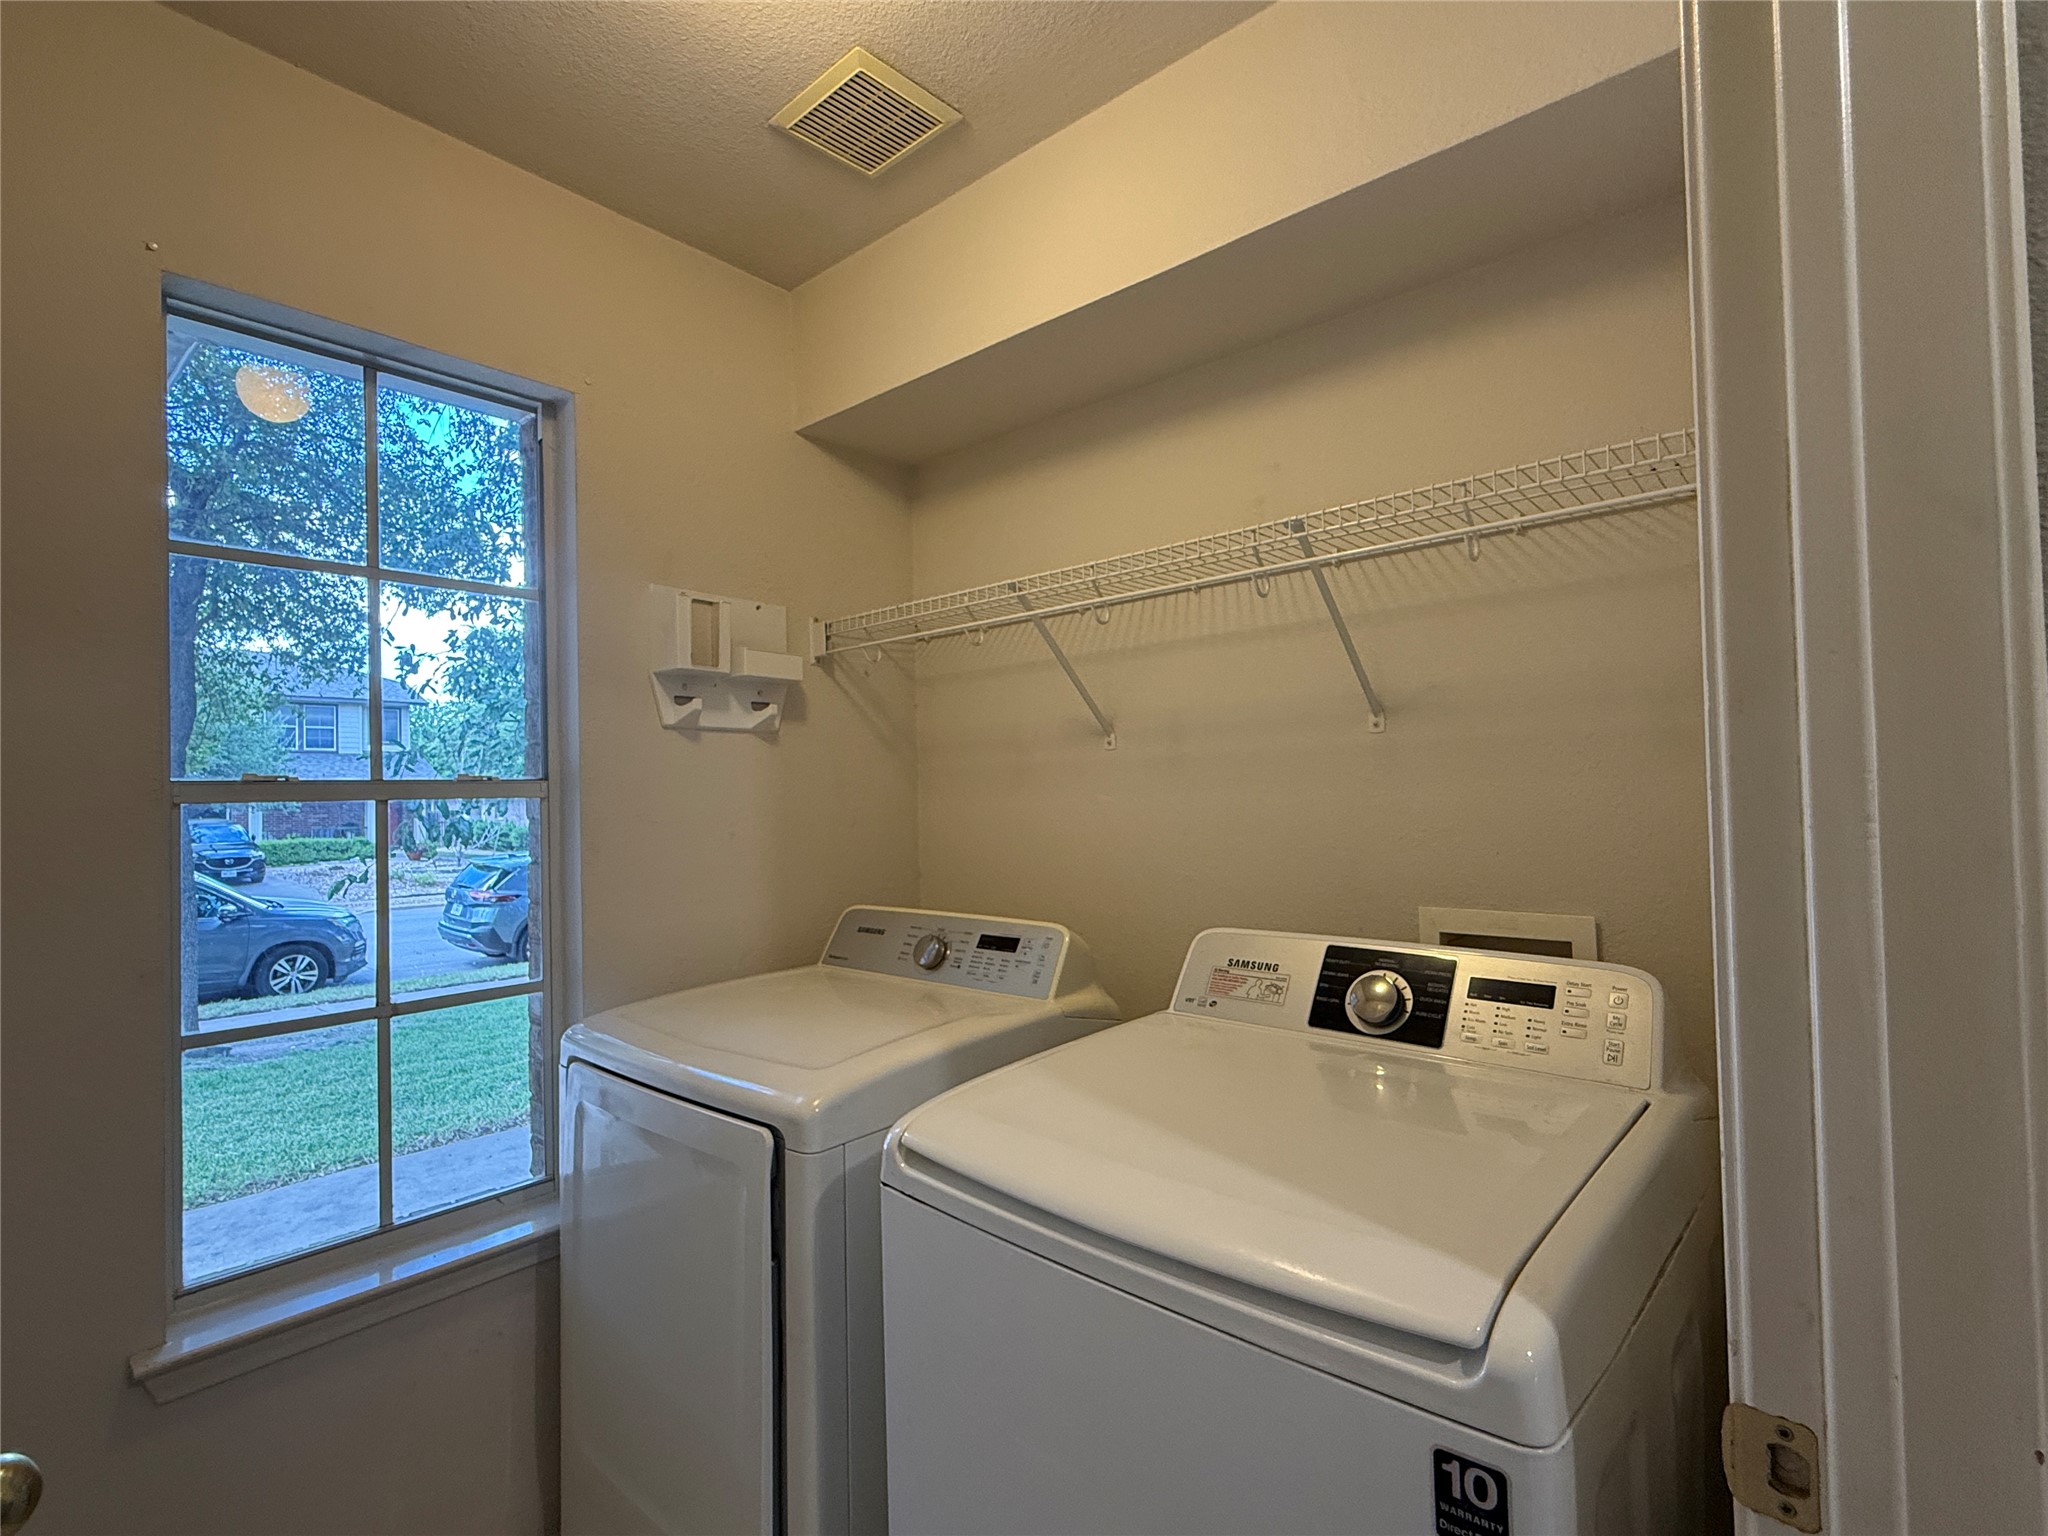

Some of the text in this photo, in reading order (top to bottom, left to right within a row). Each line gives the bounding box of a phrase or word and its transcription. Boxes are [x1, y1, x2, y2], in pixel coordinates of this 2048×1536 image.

[1227, 958, 1279, 972] SAMSUNG
[1441, 1460, 1498, 1511] 10
[1439, 1518, 1473, 1536] Direct
[1440, 1501, 1504, 1534] WARRANTY
